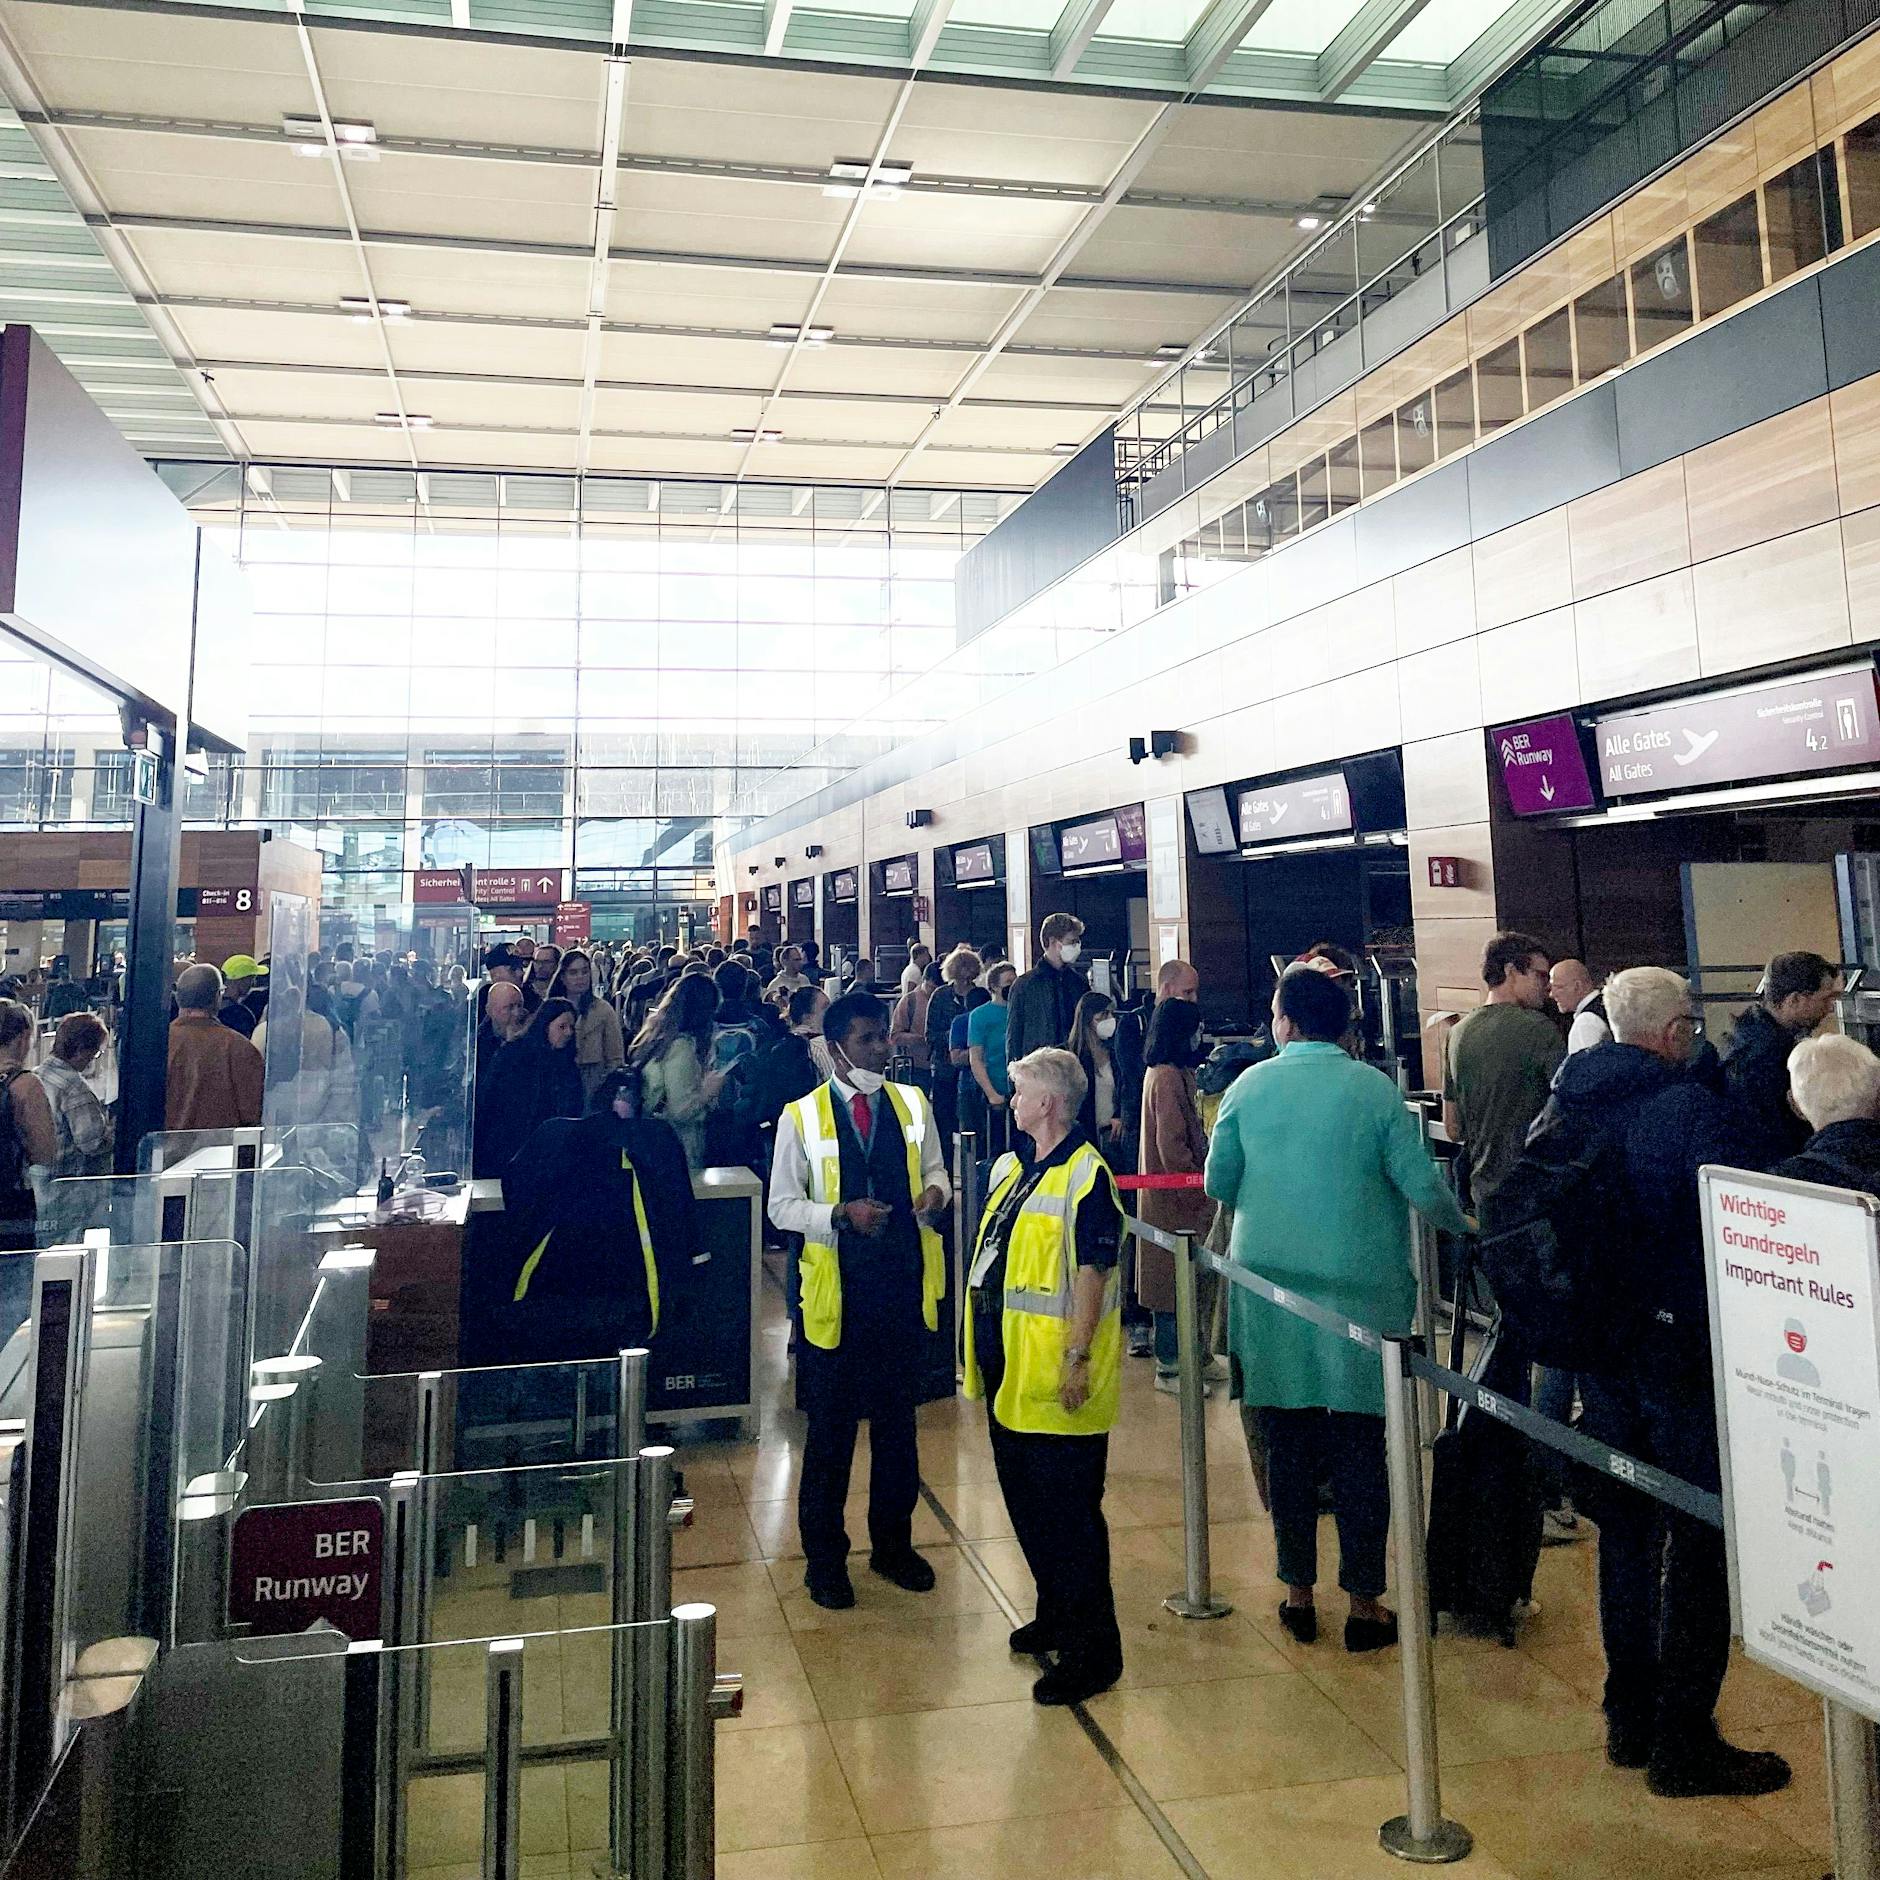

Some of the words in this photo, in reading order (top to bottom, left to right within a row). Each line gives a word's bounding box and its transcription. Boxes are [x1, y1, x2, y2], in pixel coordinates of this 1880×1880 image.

[1513, 734, 1531, 750] BER
[1605, 734, 1631, 757] Alle
[1633, 729, 1671, 752] Gates
[1516, 749, 1552, 766] Runway
[1609, 764, 1622, 782] All
[1623, 763, 1653, 780] Gates
[235, 889, 252, 911] 8
[1719, 1193, 1787, 1228] Wichtige
[1722, 1226, 1820, 1266] Grundregeln
[1725, 1258, 1803, 1297] Important
[1809, 1280, 1855, 1309] Rules
[665, 1374, 696, 1391] BER
[1477, 1390, 1498, 1415] BER
[1609, 1453, 1636, 1483] BER
[315, 1530, 371, 1558] BER
[255, 1572, 369, 1602] Runway
